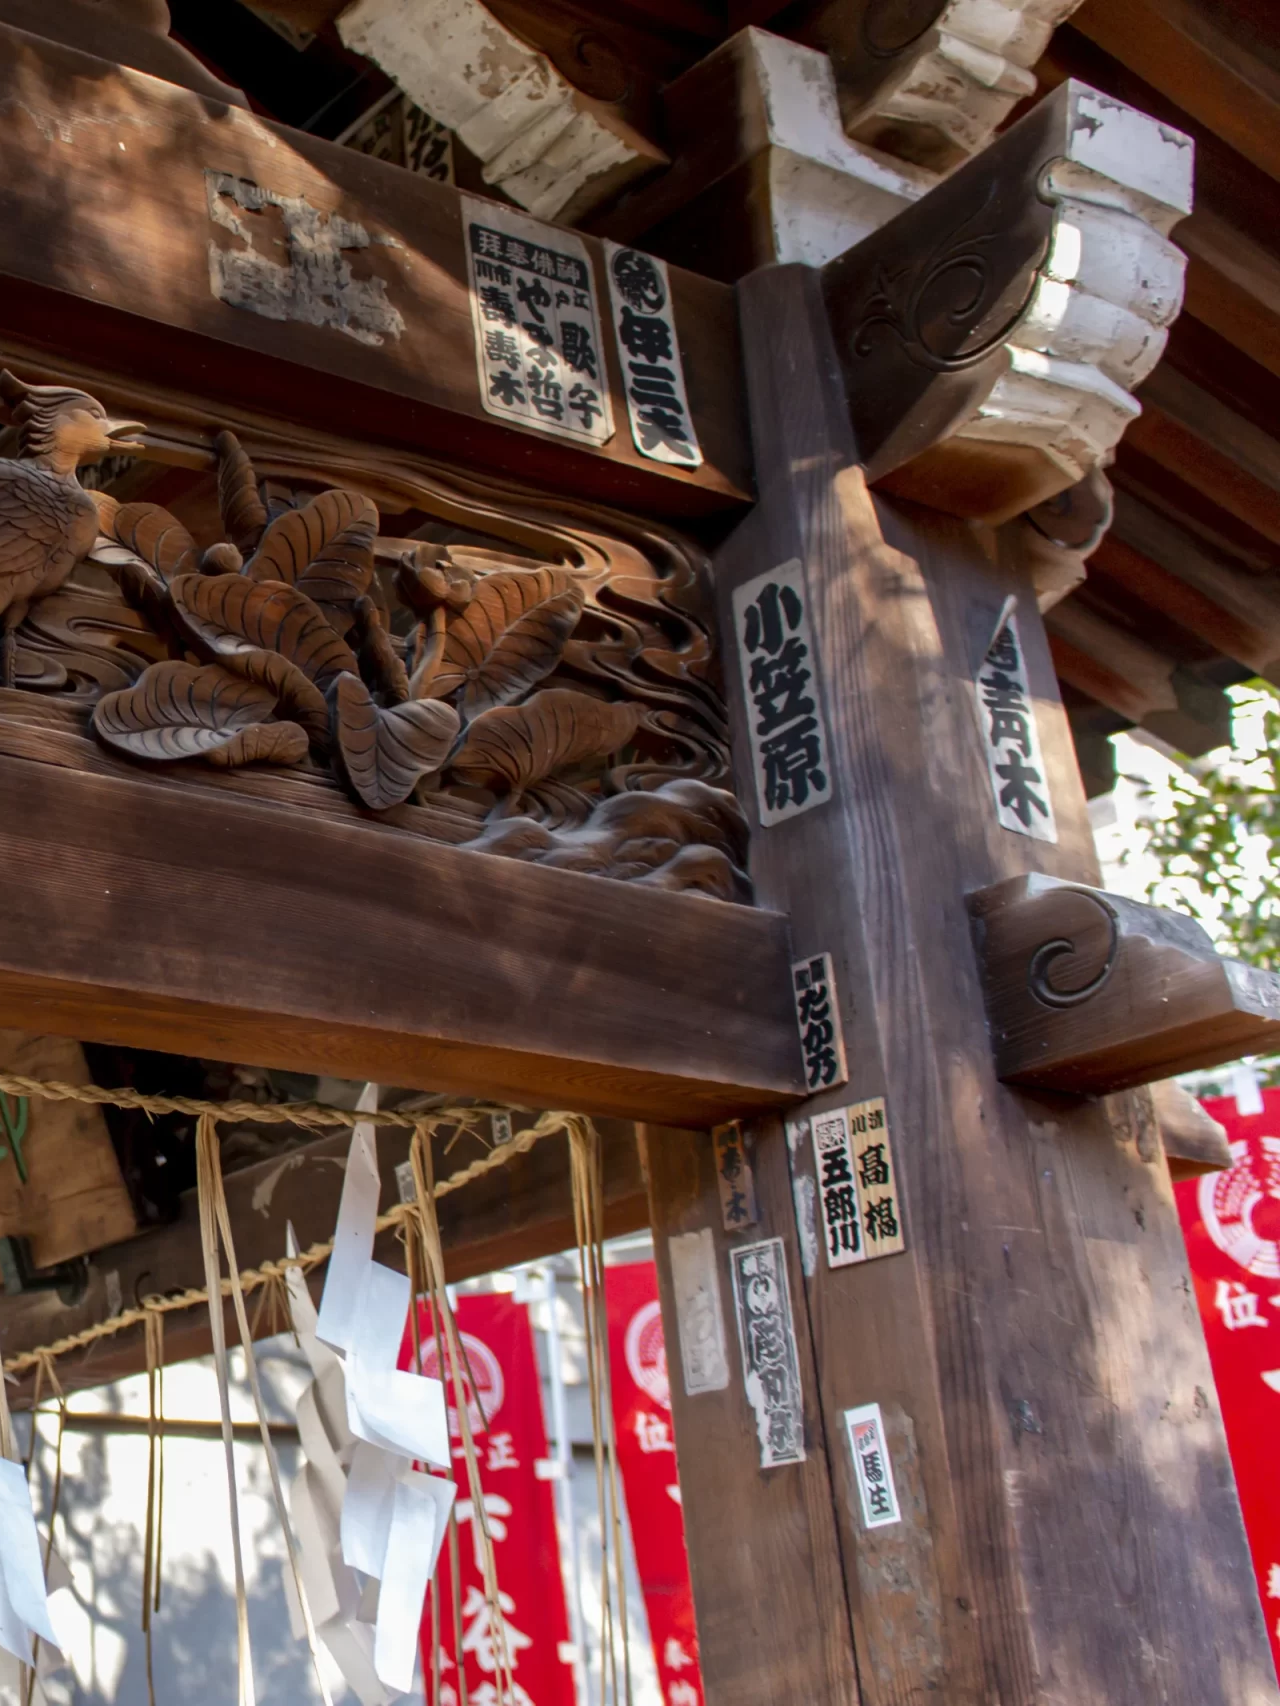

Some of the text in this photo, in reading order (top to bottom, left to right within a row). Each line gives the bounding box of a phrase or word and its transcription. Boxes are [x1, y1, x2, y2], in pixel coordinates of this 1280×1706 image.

[744, 583, 826, 811] 小笠原
[455, 1494, 536, 1706] 下谷
